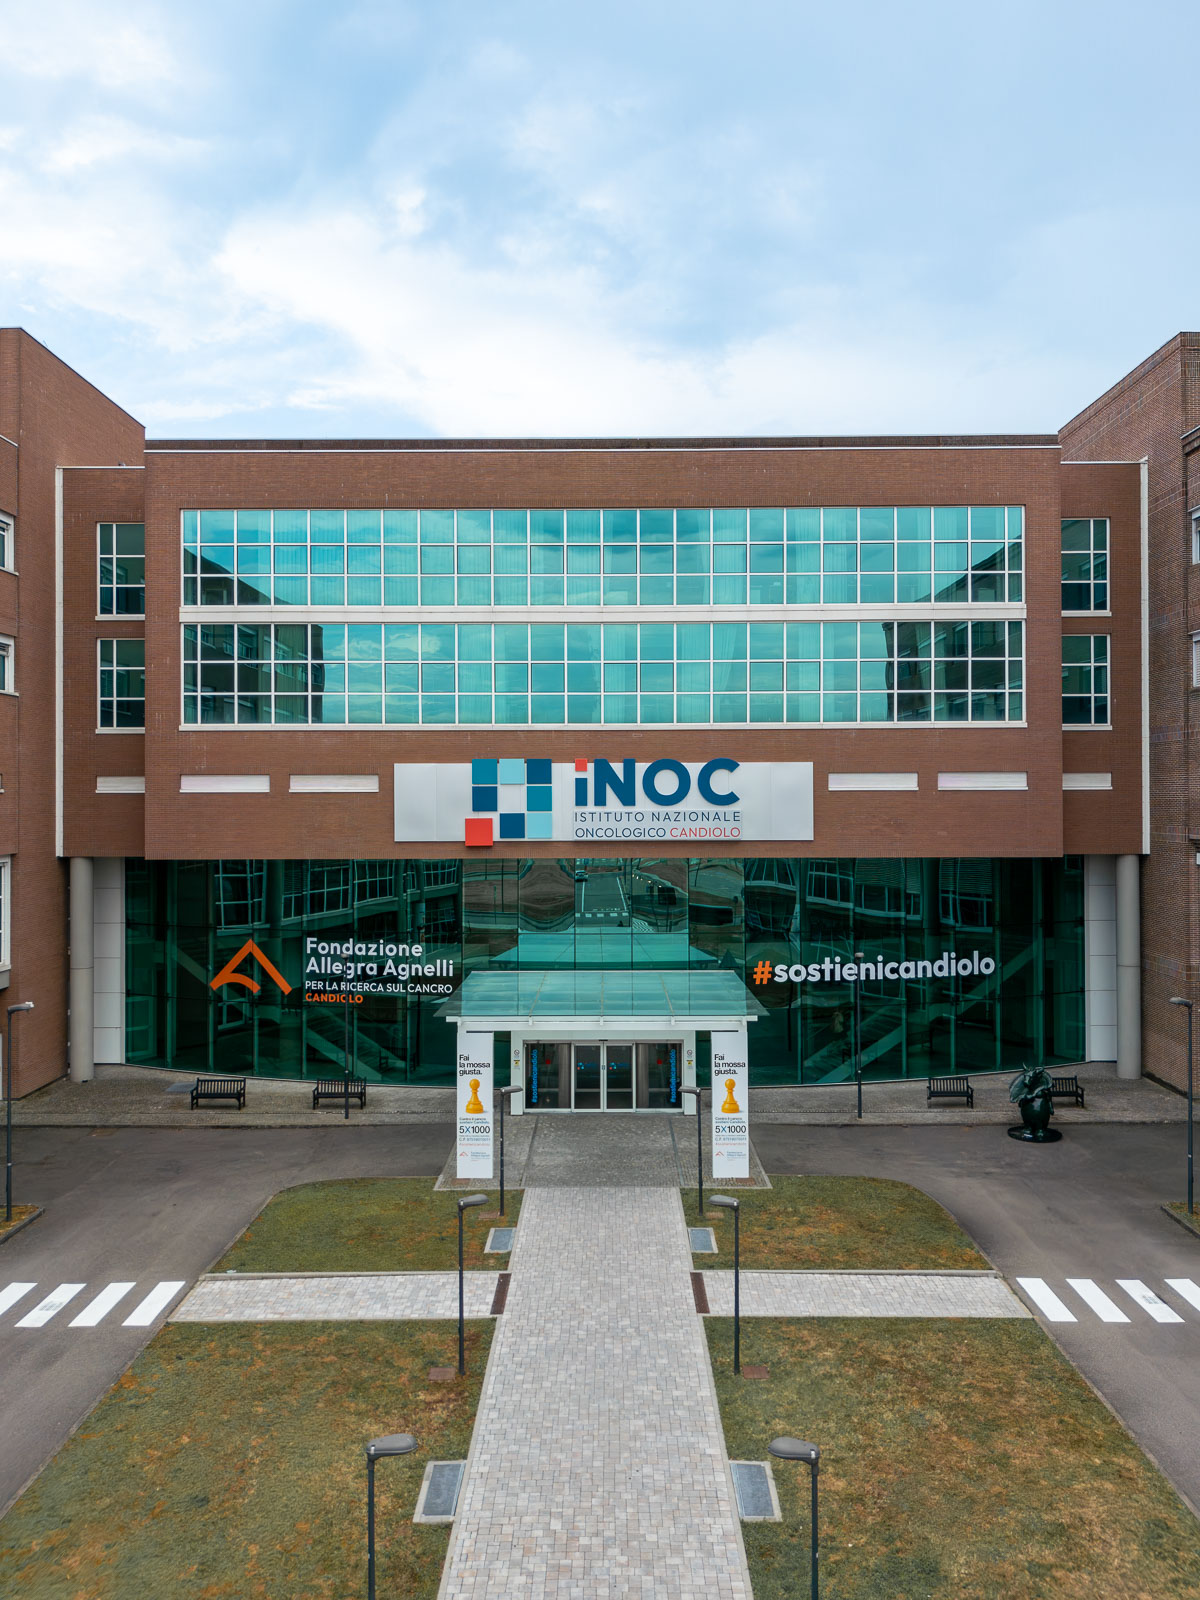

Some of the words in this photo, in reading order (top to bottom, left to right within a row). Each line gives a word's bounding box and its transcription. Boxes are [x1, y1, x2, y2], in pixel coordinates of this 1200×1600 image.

[575, 758, 741, 807] iNOC
[575, 811, 645, 822] ISTITUTO
[651, 811, 741, 822] NAZIONALE
[575, 827, 666, 838] ONCOLOGICO
[670, 827, 741, 838] CANDIOLO
[306, 937, 423, 957] Fondazione
[306, 957, 378, 979] Allegra
[383, 959, 454, 980] Agnelli
[753, 950, 996, 985] #sostienicandiolo
[305, 981, 324, 991] PER
[326, 982, 338, 991] LA
[340, 982, 384, 992] RICERCA
[386, 984, 406, 993] SUL
[407, 984, 453, 994] CANCRO
[459, 1068, 483, 1076] giusta.
[714, 1068, 738, 1076] giusta.
[459, 1125, 491, 1134] 5X1000
[715, 1125, 747, 1134] 5X1000
